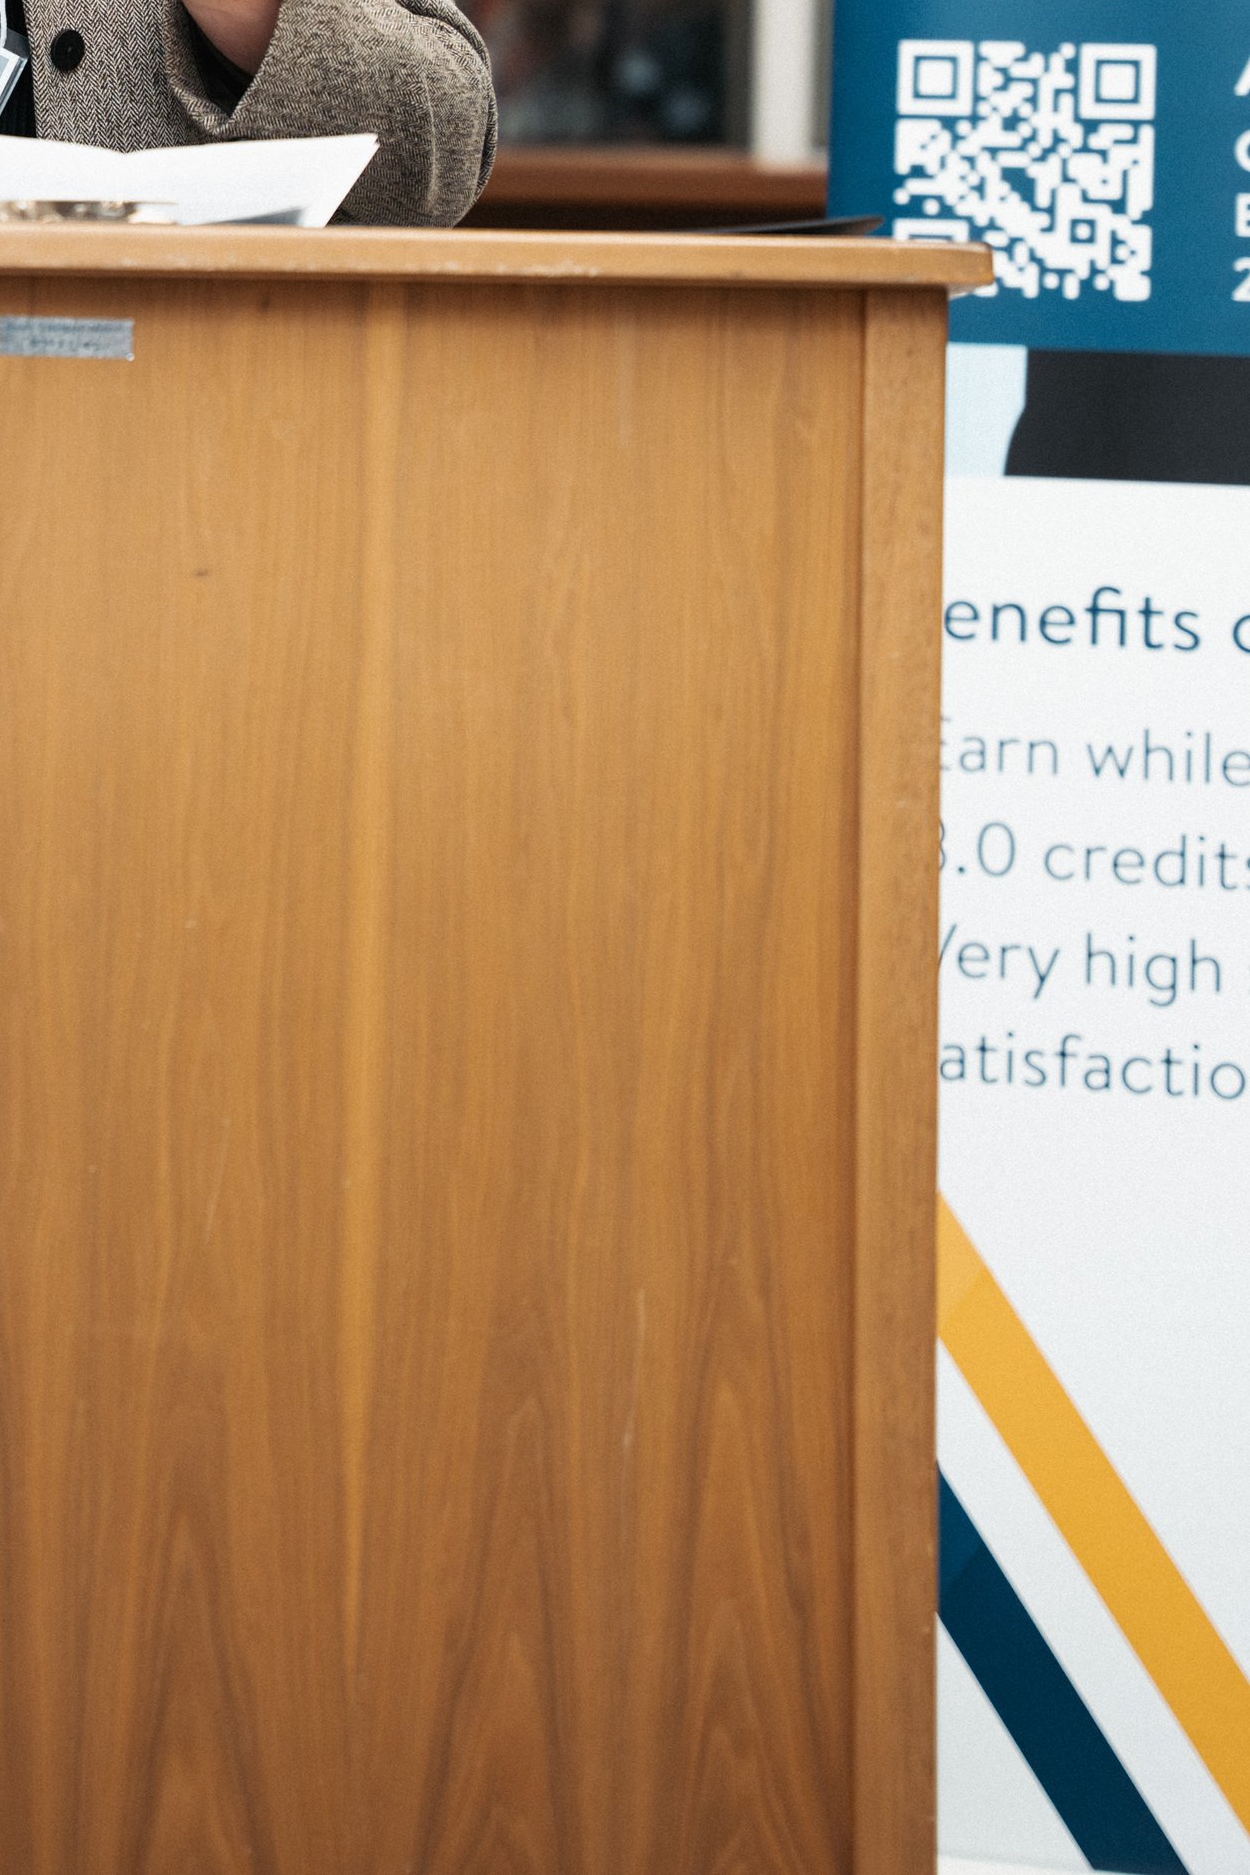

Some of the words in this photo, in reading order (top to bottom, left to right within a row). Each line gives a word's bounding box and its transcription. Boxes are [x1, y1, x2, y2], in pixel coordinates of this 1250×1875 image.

[1086, 727, 1250, 788] while
[1044, 834, 1250, 892] credit
[1085, 931, 1222, 1008] high
